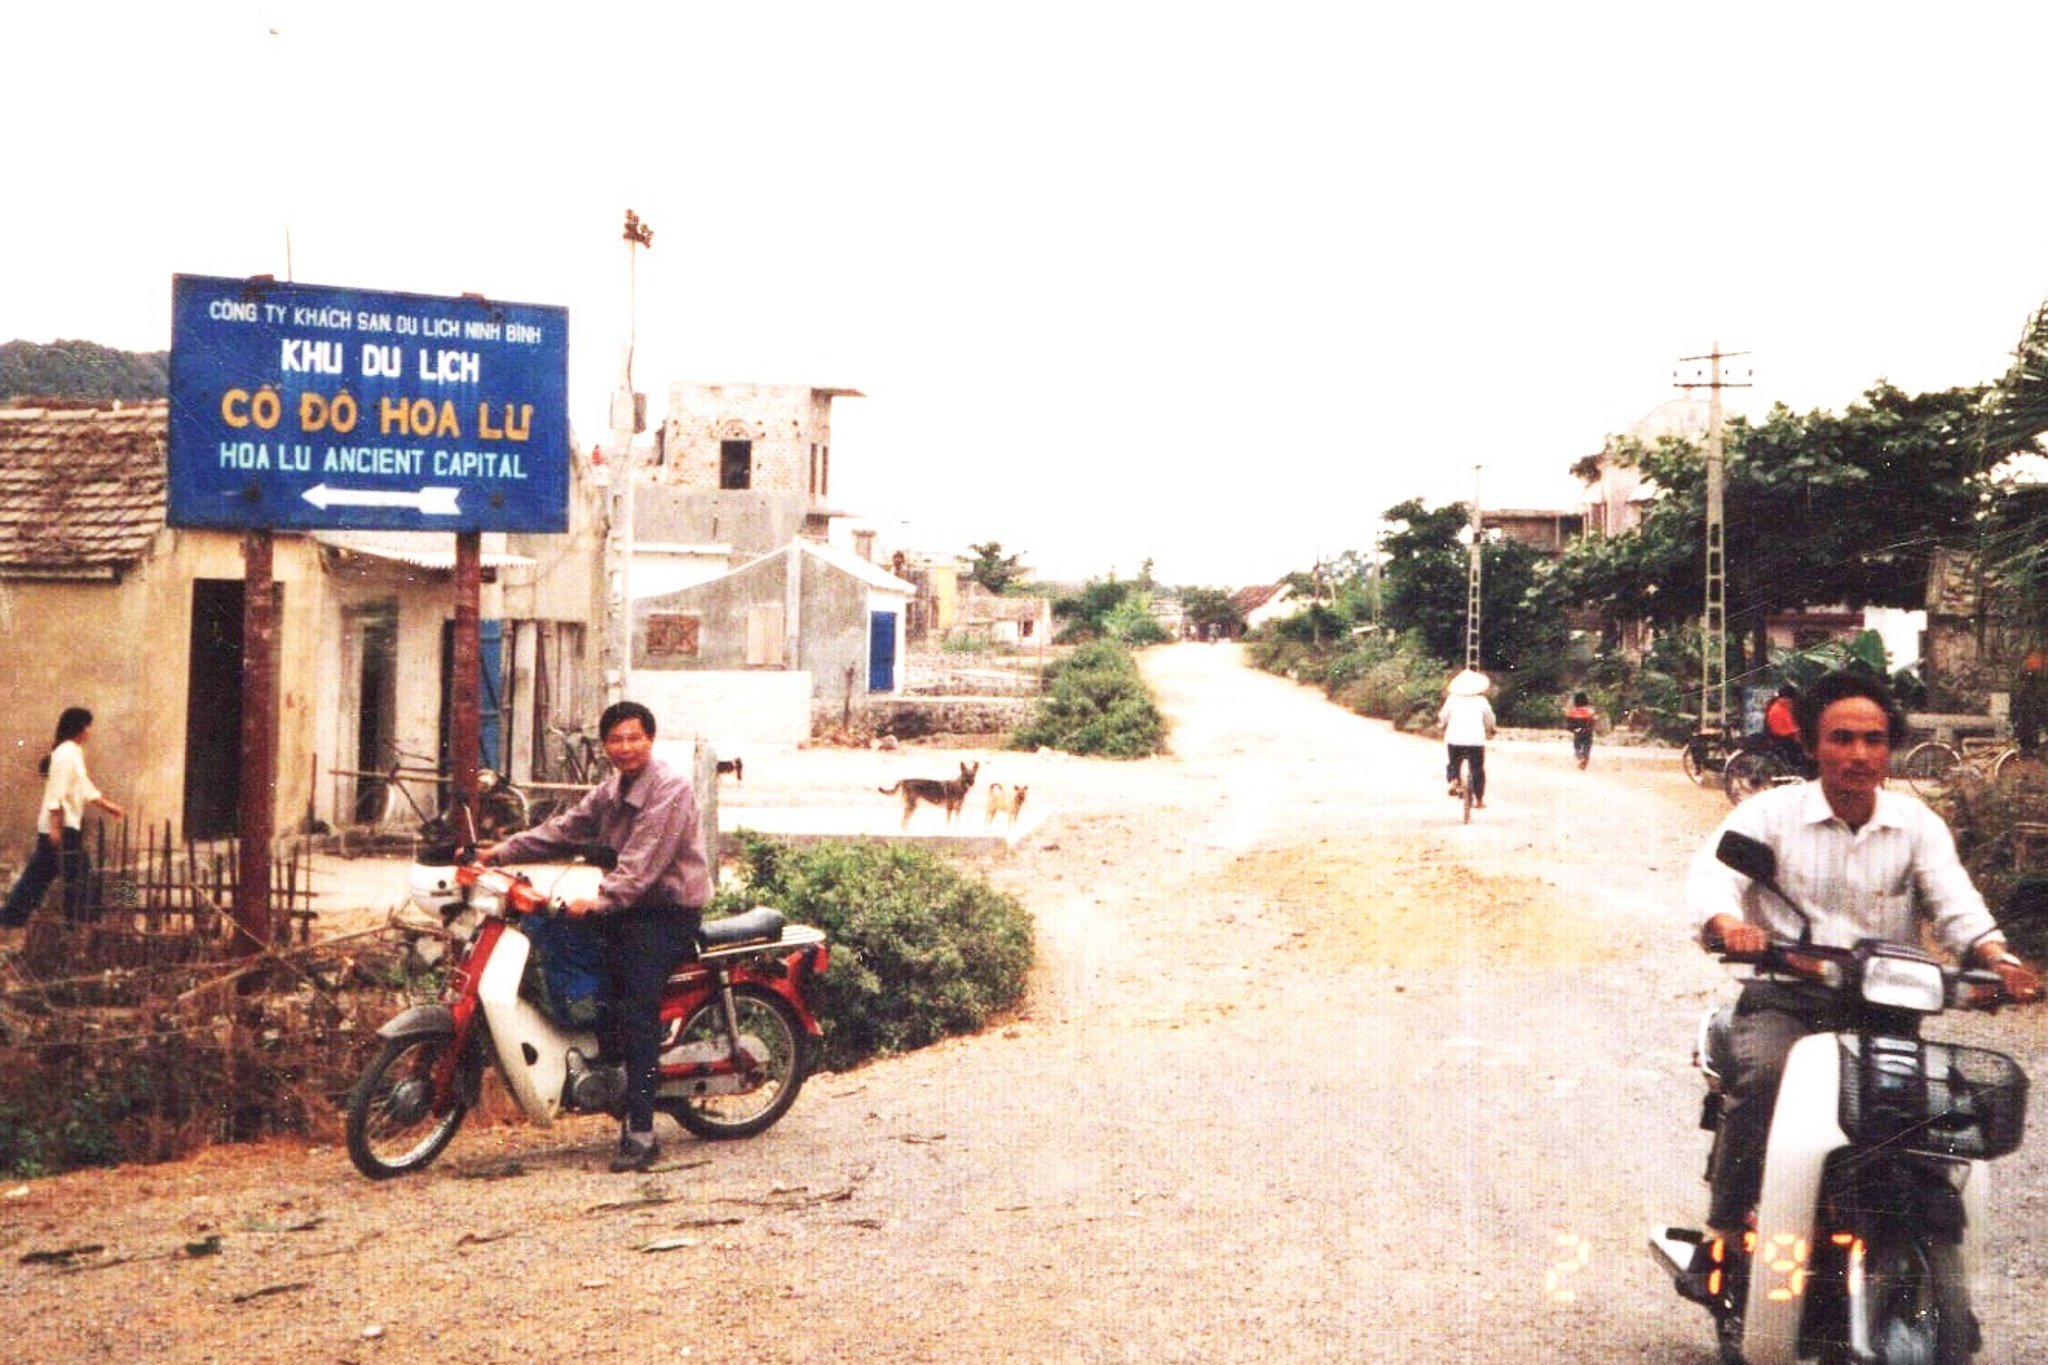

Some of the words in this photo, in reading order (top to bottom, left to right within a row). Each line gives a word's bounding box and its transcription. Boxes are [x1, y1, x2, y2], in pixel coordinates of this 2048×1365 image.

[209, 299, 258, 323] CÔNG
[265, 304, 287, 325] TY
[465, 321, 500, 341] NINH
[281, 339, 342, 374] KHU
[362, 344, 400, 377] DU
[419, 348, 480, 386] LỊCH
[299, 388, 358, 433] ĐÔ
[380, 396, 461, 439] HOA
[220, 442, 271, 470] HOA
[278, 444, 312, 471] LU
[324, 446, 425, 475] ANCIENT
[433, 449, 528, 479] CAPITAL
